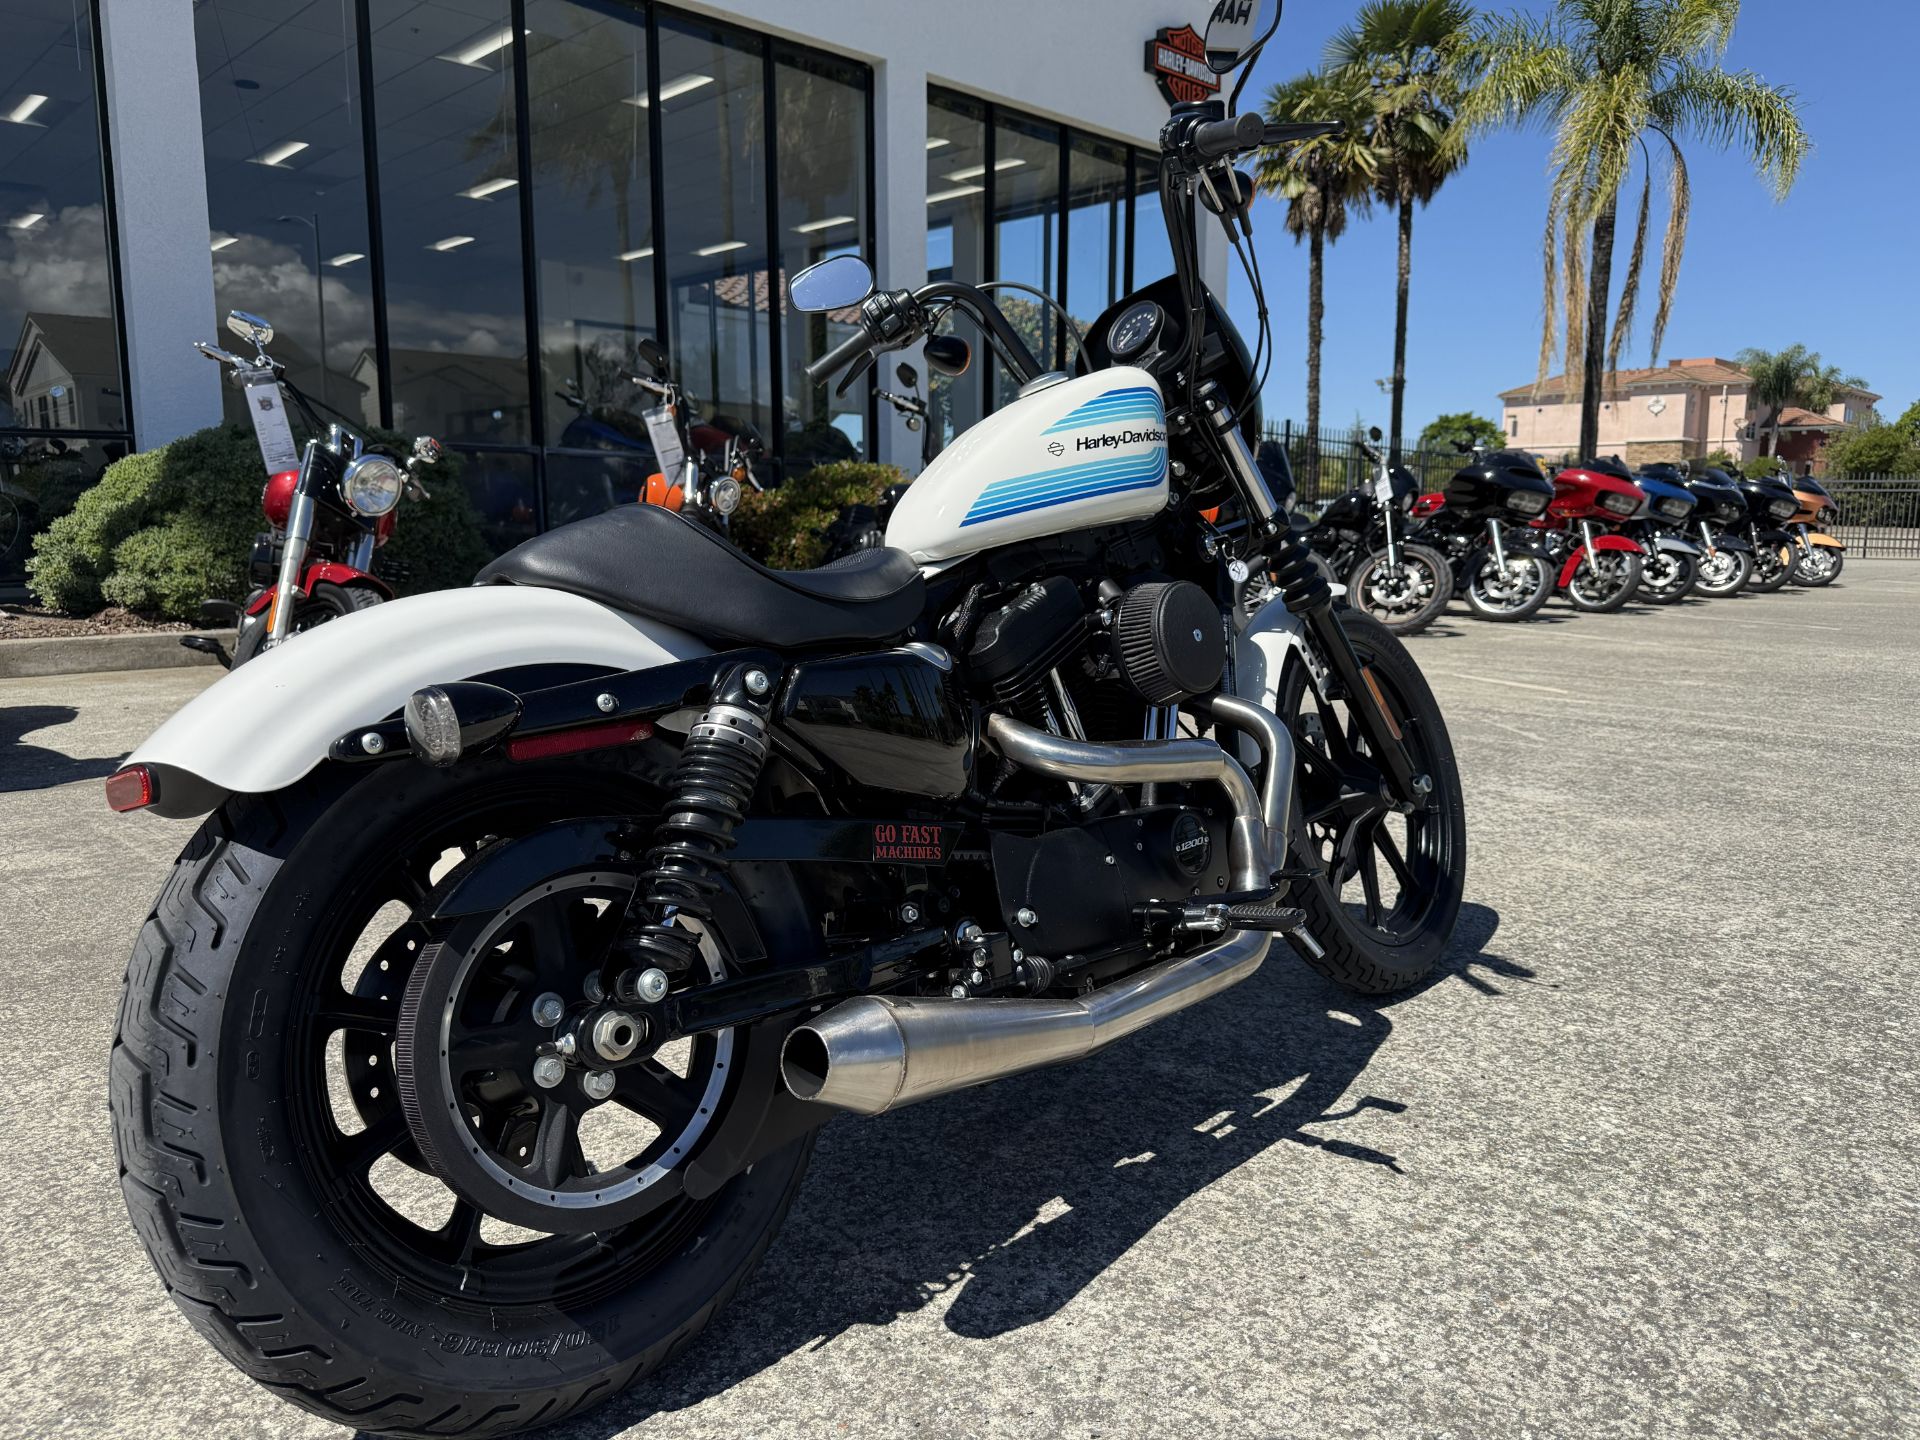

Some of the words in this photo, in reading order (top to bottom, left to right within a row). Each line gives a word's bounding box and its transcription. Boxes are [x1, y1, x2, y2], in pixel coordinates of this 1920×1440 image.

[874, 824, 897, 843] GO
[901, 825, 942, 845] FAST
[1180, 836, 1204, 851] 1200
[875, 845, 942, 860] MACHINES
